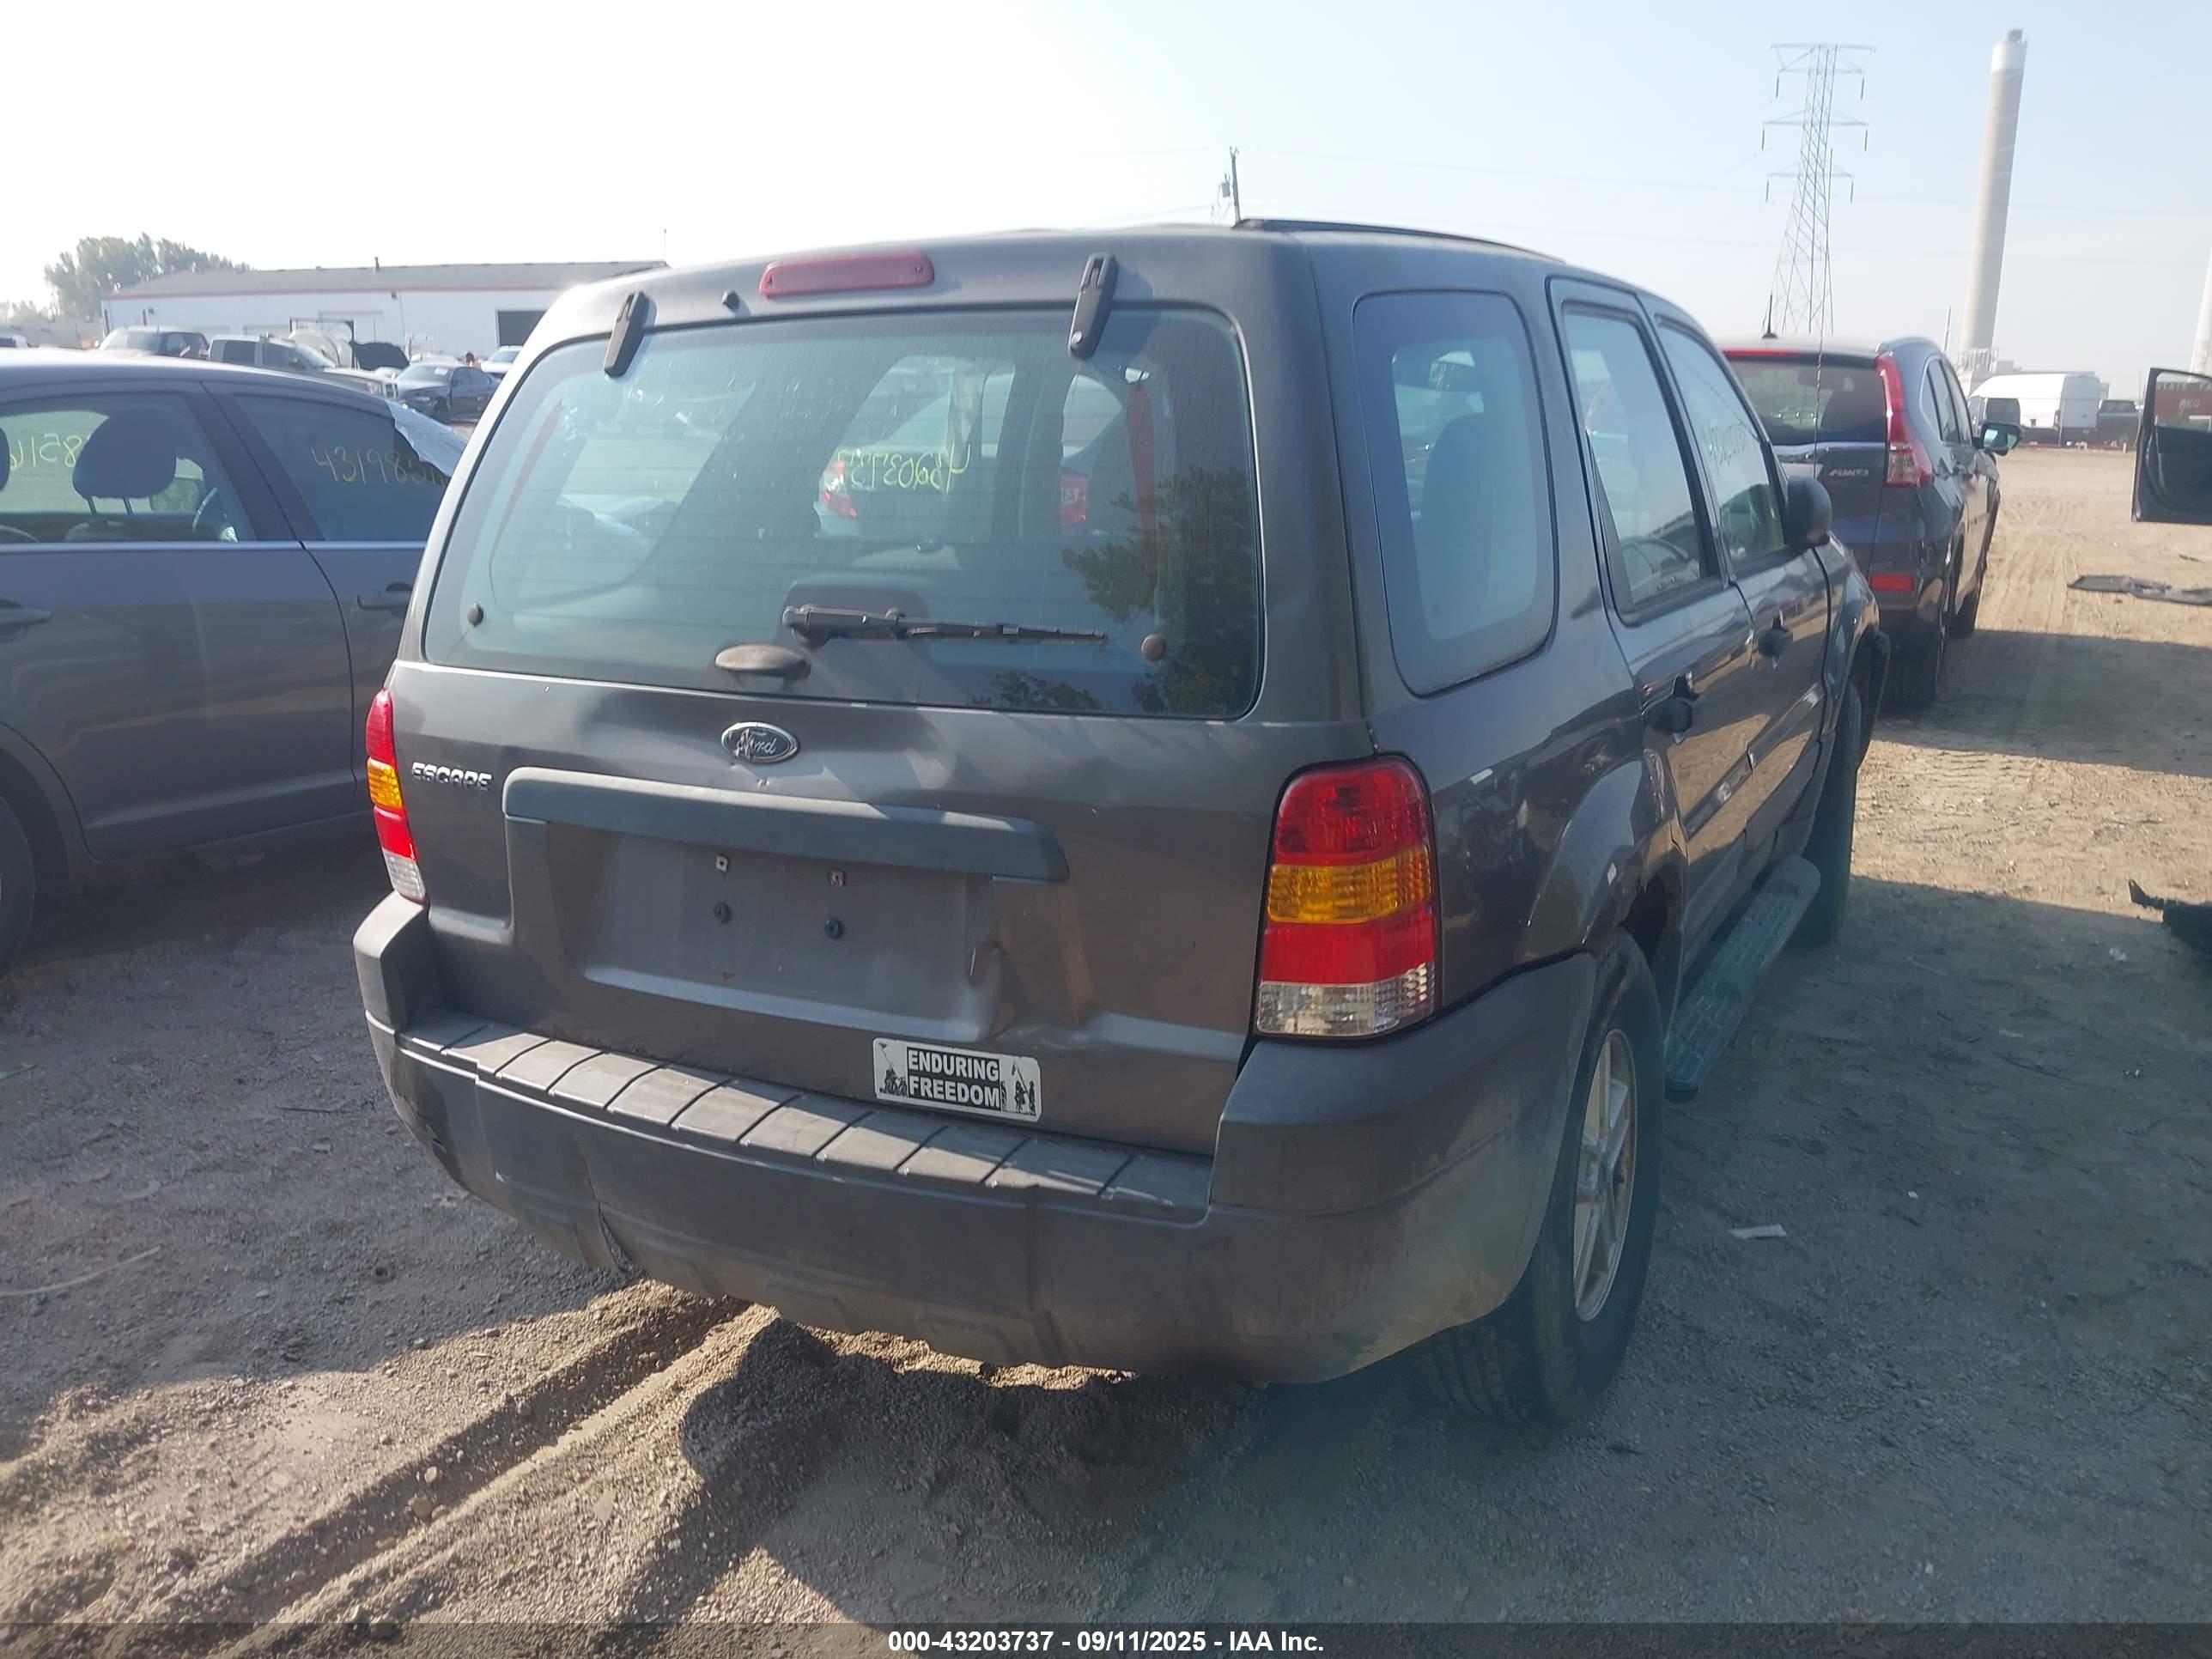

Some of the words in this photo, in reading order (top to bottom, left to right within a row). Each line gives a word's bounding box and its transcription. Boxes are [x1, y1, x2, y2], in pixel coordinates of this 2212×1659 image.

[412, 762, 493, 791] ESCAPE
[908, 1049, 1000, 1082] ENDURING
[908, 1075, 1000, 1109] FREEDOM
